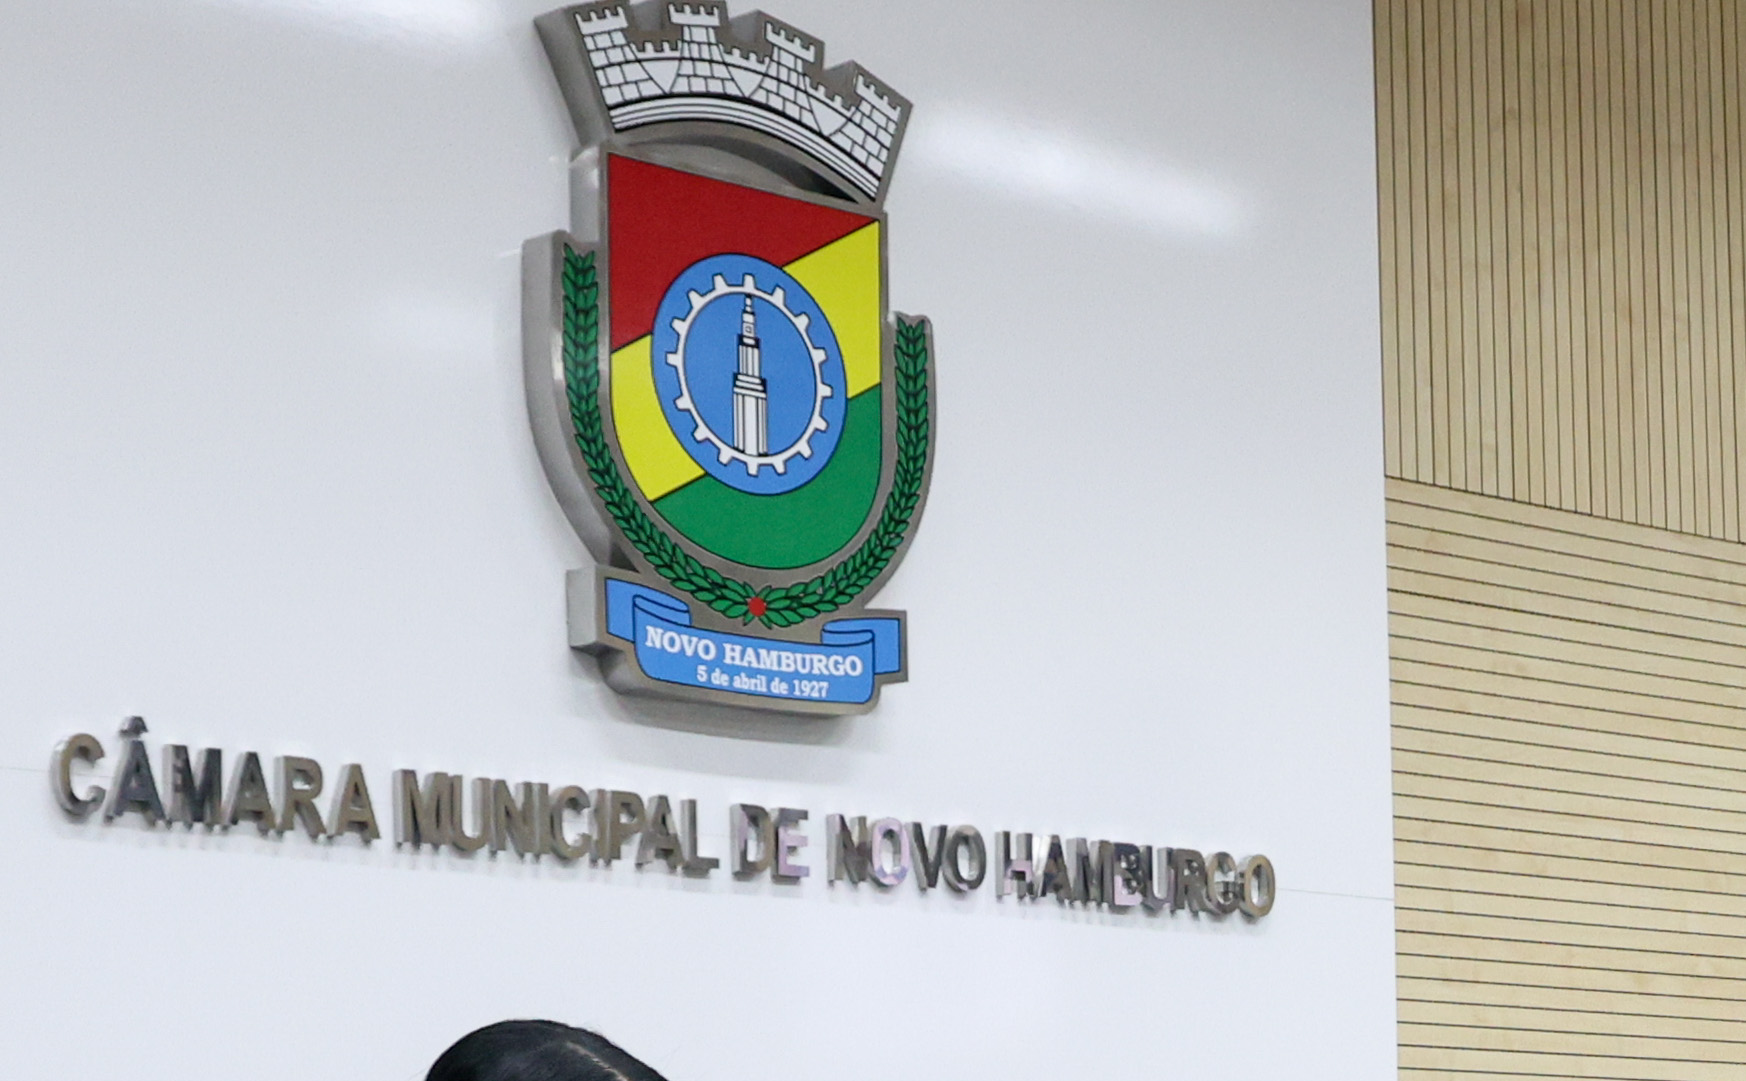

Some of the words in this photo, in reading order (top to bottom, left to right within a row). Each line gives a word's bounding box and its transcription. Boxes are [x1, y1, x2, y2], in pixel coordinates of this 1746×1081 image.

[644, 625, 716, 661] NOVO
[722, 642, 864, 677] HAMBURGO
[696, 665, 708, 682] 5
[711, 667, 730, 687] de
[733, 670, 767, 693] abril
[770, 676, 789, 695] de
[792, 679, 829, 699] 1927
[50, 715, 380, 843] CÂMARA
[392, 768, 720, 874] MUNICIPAL
[730, 803, 810, 883] DE
[826, 813, 986, 893] NOVO
[995, 830, 1276, 925] HAMBURGO
